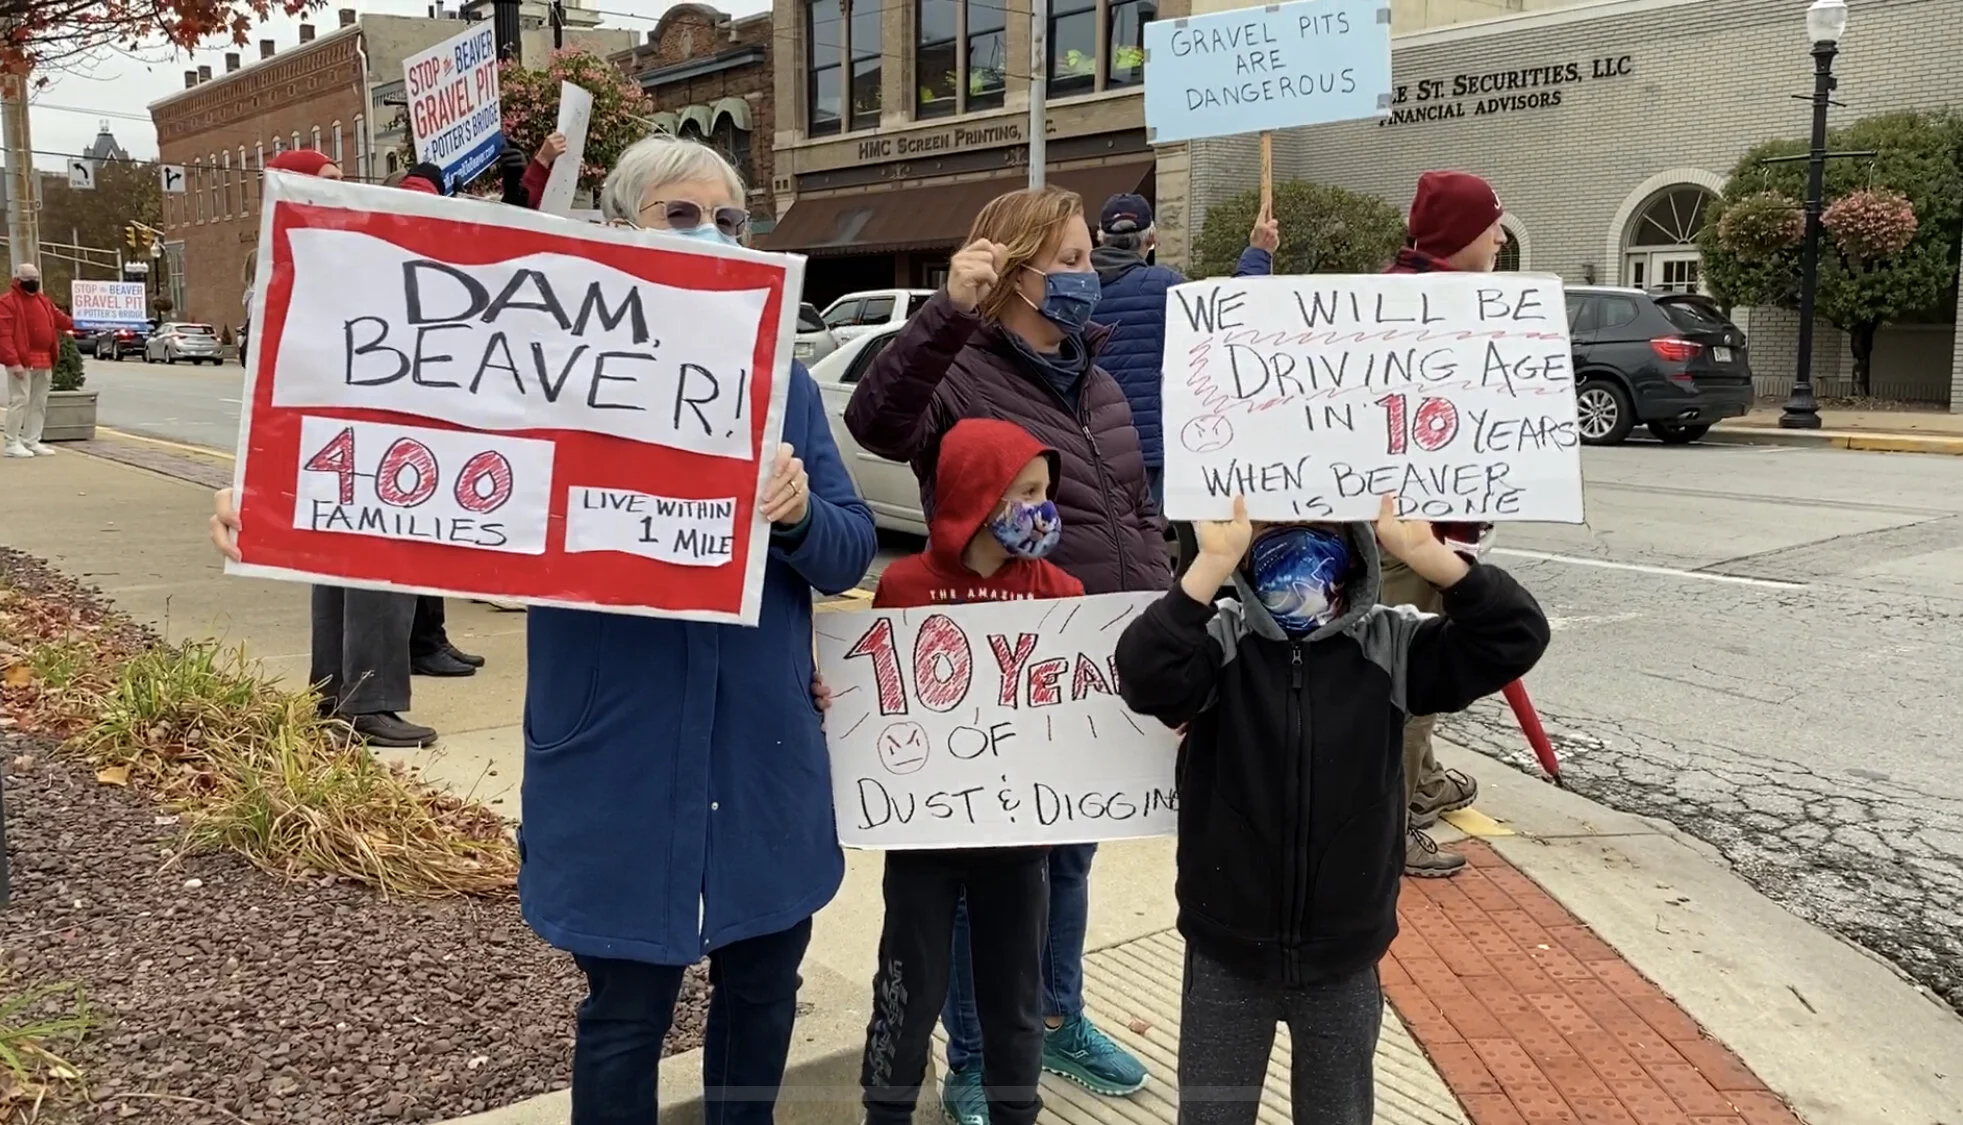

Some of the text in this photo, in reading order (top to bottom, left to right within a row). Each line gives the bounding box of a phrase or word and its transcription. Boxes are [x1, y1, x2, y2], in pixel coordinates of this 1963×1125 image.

[1171, 12, 1350, 57] GRAVEL PITS
[408, 56, 440, 97] STOP
[454, 29, 494, 74] BEAVER
[1236, 49, 1287, 76] ARE
[1417, 79, 1445, 101] ST.
[1452, 62, 1582, 96] SECURITIES,
[1591, 55, 1632, 79] LLC
[414, 60, 496, 139] GRAVEL PIT
[1186, 68, 1356, 111] DANGEROUS
[1474, 91, 1562, 115] ADVISORS
[431, 121, 472, 162] POTTER'S
[471, 102, 498, 137] BRIDGE
[859, 140, 891, 160] HMC
[897, 134, 949, 154] SCREEN
[954, 124, 1021, 147] PRINTING,
[74, 283, 97, 294] STOP
[109, 284, 143, 295] BEAVER
[75, 295, 143, 309] GRAVEL PIT
[401, 259, 661, 348] DAM,
[1176, 286, 1547, 333] WE WILL BE
[344, 315, 745, 439] BEAVER!
[1224, 341, 1570, 400] DRIVING AGE
[1305, 392, 1578, 455] IN 10 YEARS
[304, 427, 514, 514] 400
[1202, 455, 1526, 497] WHEN BEAVER
[312, 500, 507, 547] FAMILIES
[583, 489, 732, 519] LIVE WITHIN
[1293, 493, 1521, 517] IS DONE
[638, 516, 736, 558] 1 MILE
[929, 588, 957, 600] THE
[843, 613, 973, 717] 10
[947, 722, 1017, 760] OF
[857, 777, 985, 830] DUST
[998, 774, 1021, 823] &
